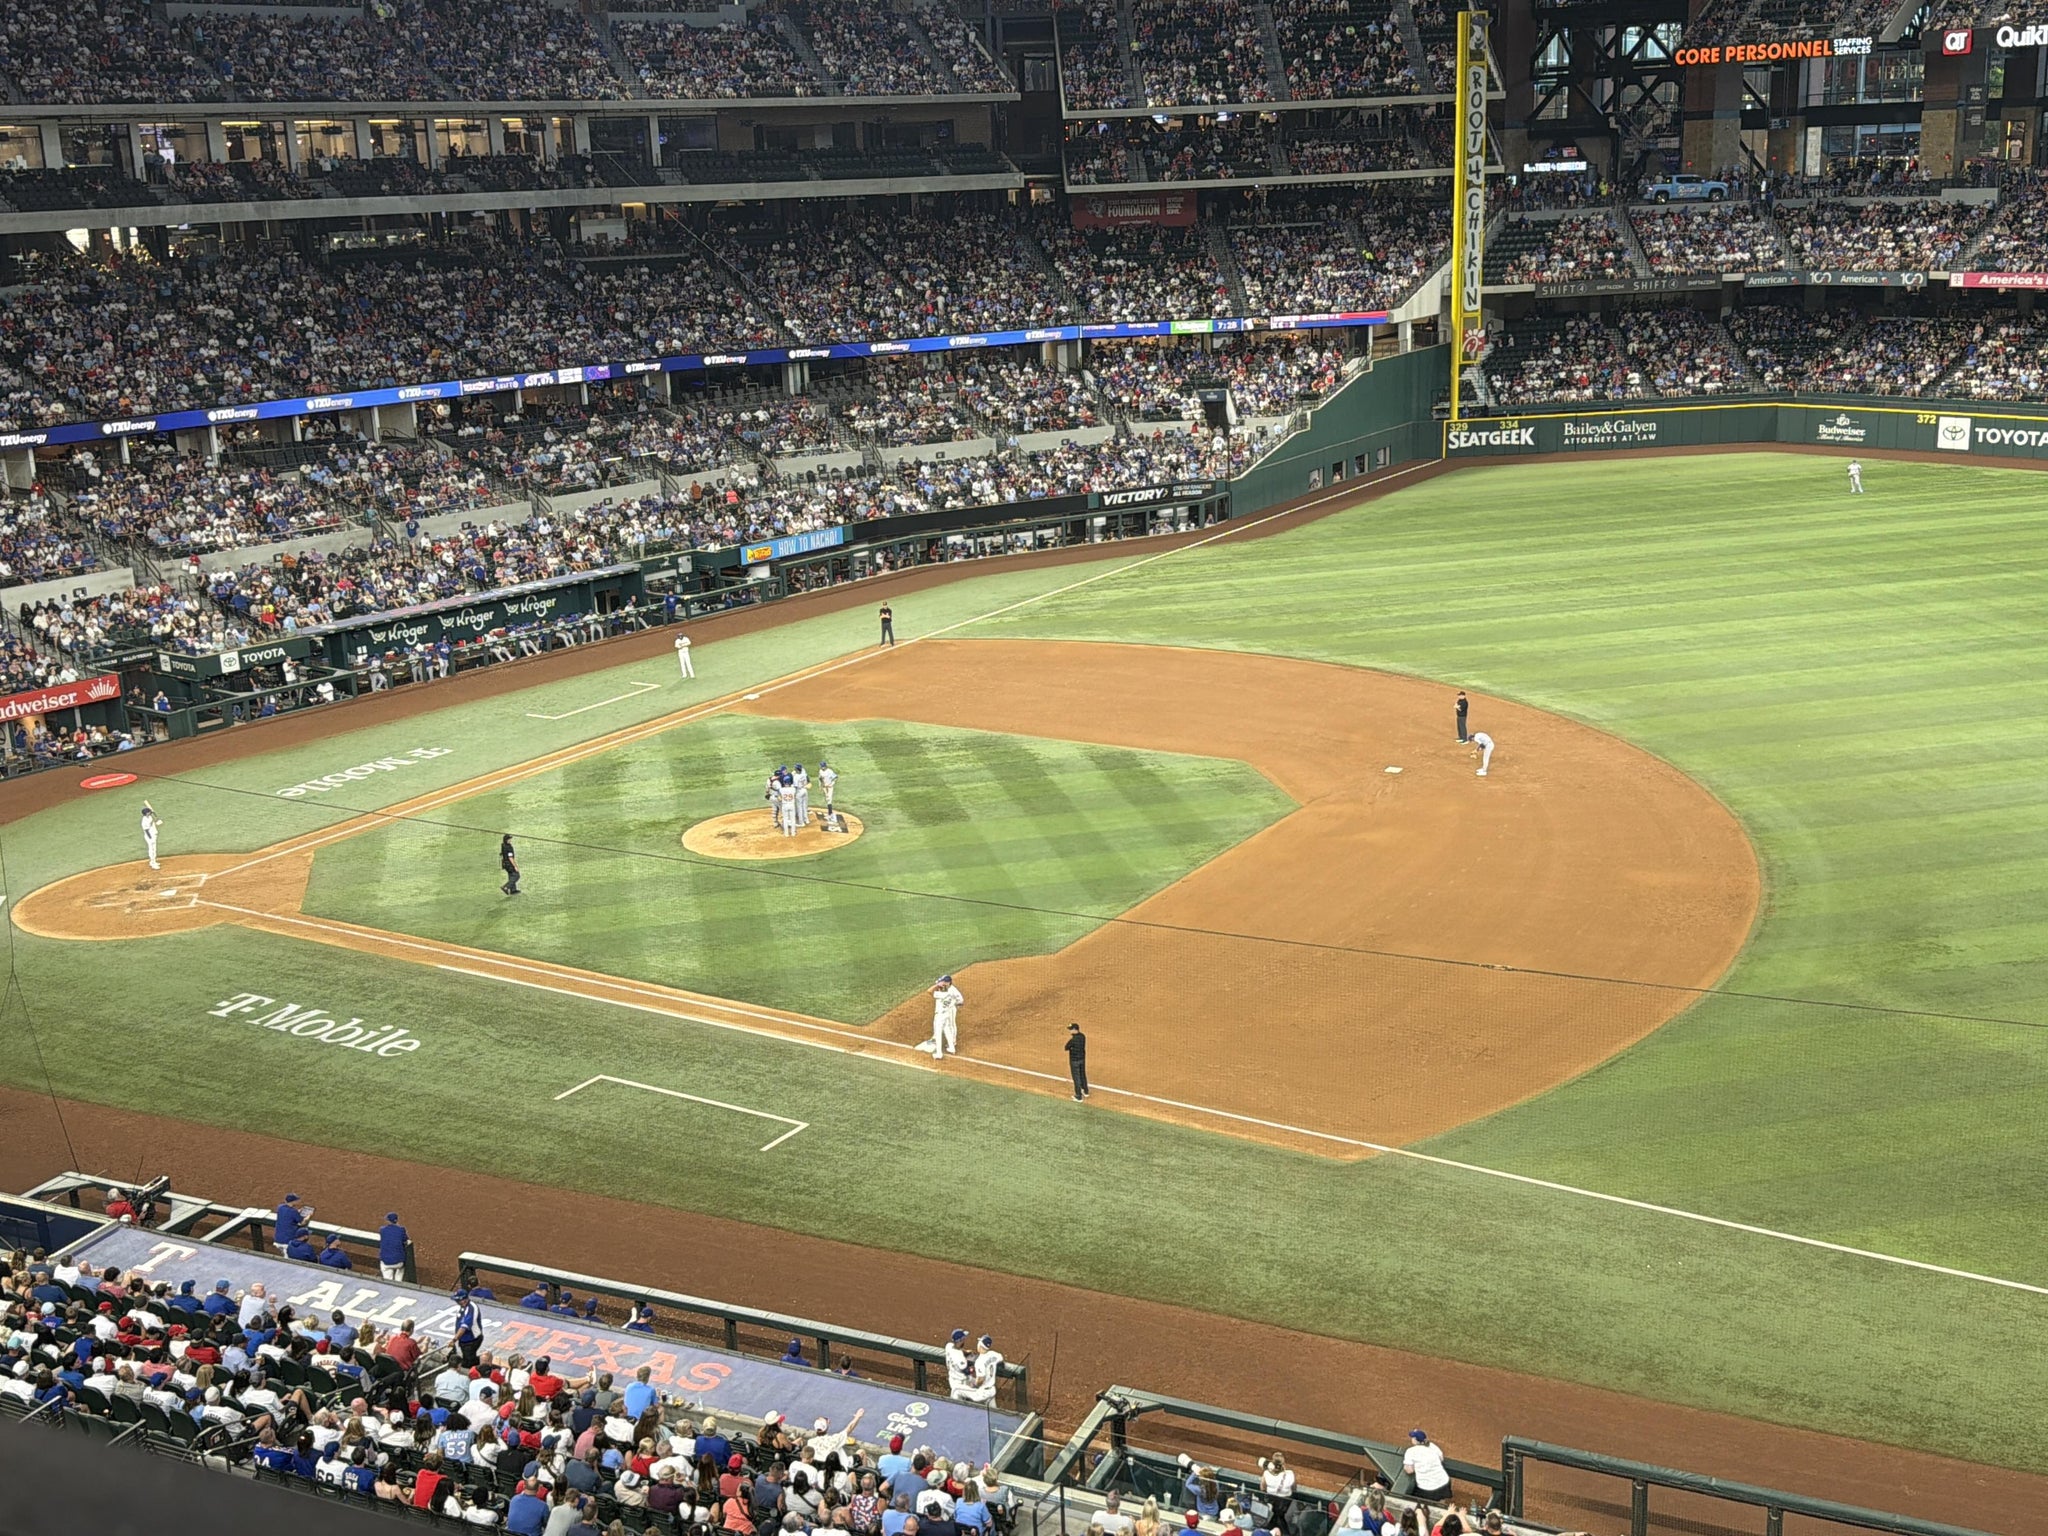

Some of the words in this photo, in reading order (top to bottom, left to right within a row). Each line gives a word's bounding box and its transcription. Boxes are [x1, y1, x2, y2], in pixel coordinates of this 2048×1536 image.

[1833, 37, 1873, 48] STAFFING
[1945, 32, 1969, 51] QT
[1675, 48, 1721, 66] CORE
[1725, 40, 1832, 63] PERSONNEL
[1834, 46, 1872, 56] SERVICES
[1108, 203, 1160, 218] FOUNDATION
[1749, 276, 1788, 285] American
[1840, 275, 1878, 284] American
[1979, 274, 2043, 285] America's
[404, 389, 421, 398] TXU
[313, 399, 331, 409] TXU
[216, 409, 235, 420] TXU
[234, 408, 258, 419] energy
[1916, 414, 1937, 425] 372
[111, 422, 131, 433] TXU
[130, 420, 157, 432] energy
[1450, 423, 1469, 432] 329
[1500, 420, 1519, 430] 334
[1563, 420, 1658, 438] Bailey&Galyen
[1818, 424, 1867, 436] Budweiser
[20, 433, 47, 445] energy
[1448, 427, 1535, 449] SEATGEEK
[1563, 435, 1618, 445] ATTORNEYS
[1621, 434, 1632, 442] AT
[1637, 433, 1657, 441] LAW
[1974, 427, 2048, 447] TOYOTA
[1103, 487, 1165, 506] VICTORY
[778, 540, 796, 556] HOW
[799, 536, 809, 551] TO
[810, 530, 838, 549] NACHO!
[521, 595, 557, 617] Kroger
[456, 608, 494, 631] Kroger
[388, 622, 429, 645] Kroger
[242, 647, 286, 664] TOYOTA
[171, 660, 196, 673] TOYOTA
[245, 1003, 421, 1057] Mobile
[286, 1280, 417, 1326] ALL
[493, 1320, 732, 1392] TEXAS
[887, 1412, 928, 1428] Globe
[886, 1421, 913, 1435] Life
[446, 1441, 467, 1456] 53
